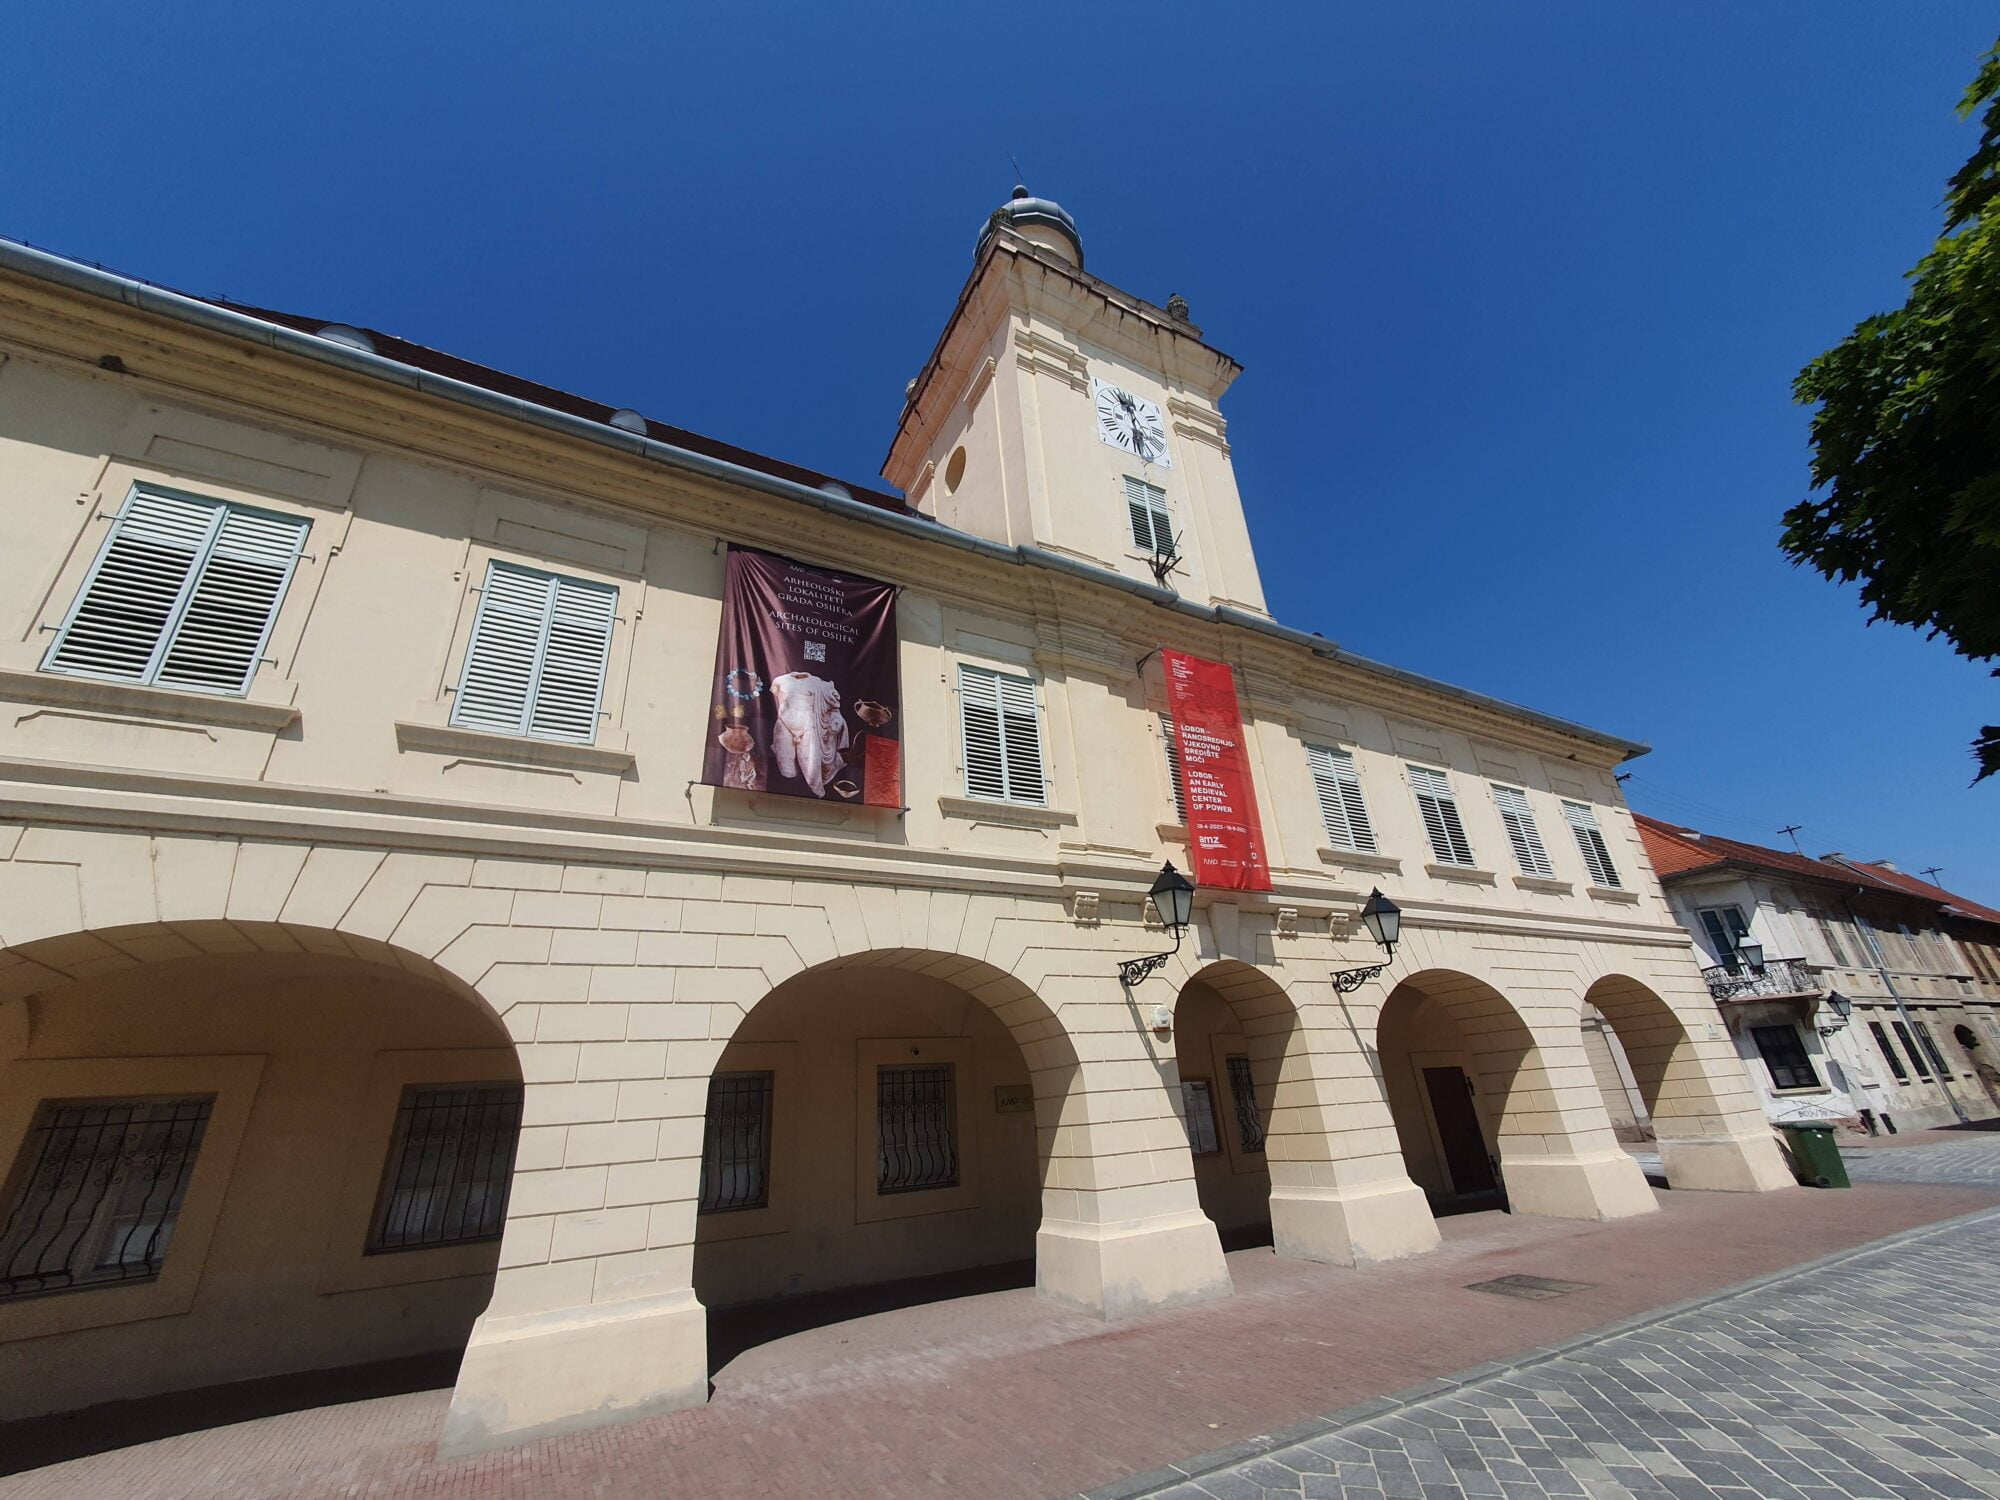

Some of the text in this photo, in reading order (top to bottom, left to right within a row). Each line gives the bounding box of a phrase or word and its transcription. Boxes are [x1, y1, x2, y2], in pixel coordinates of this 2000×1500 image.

[784, 576, 845, 597] ARHEOLOŠKI
[789, 586, 843, 605] LOKALITETI
[777, 592, 853, 617] GRADA OSIJEKA
[768, 611, 860, 635] ARCHAEOLOGICAL
[775, 621, 854, 644] SITES OF OSIJEK
[1181, 724, 1205, 734] LOBOR
[1183, 740, 1220, 751] VJEKOVNO
[1184, 747, 1220, 759] SREDIŠTE
[1188, 771, 1213, 779] LOBOR
[1202, 780, 1224, 789] EARLY
[1190, 787, 1228, 797] MEDIEVAL
[1192, 795, 1222, 804] CENTER
[1206, 805, 1232, 813] POWER
[1199, 835, 1220, 844] amz
